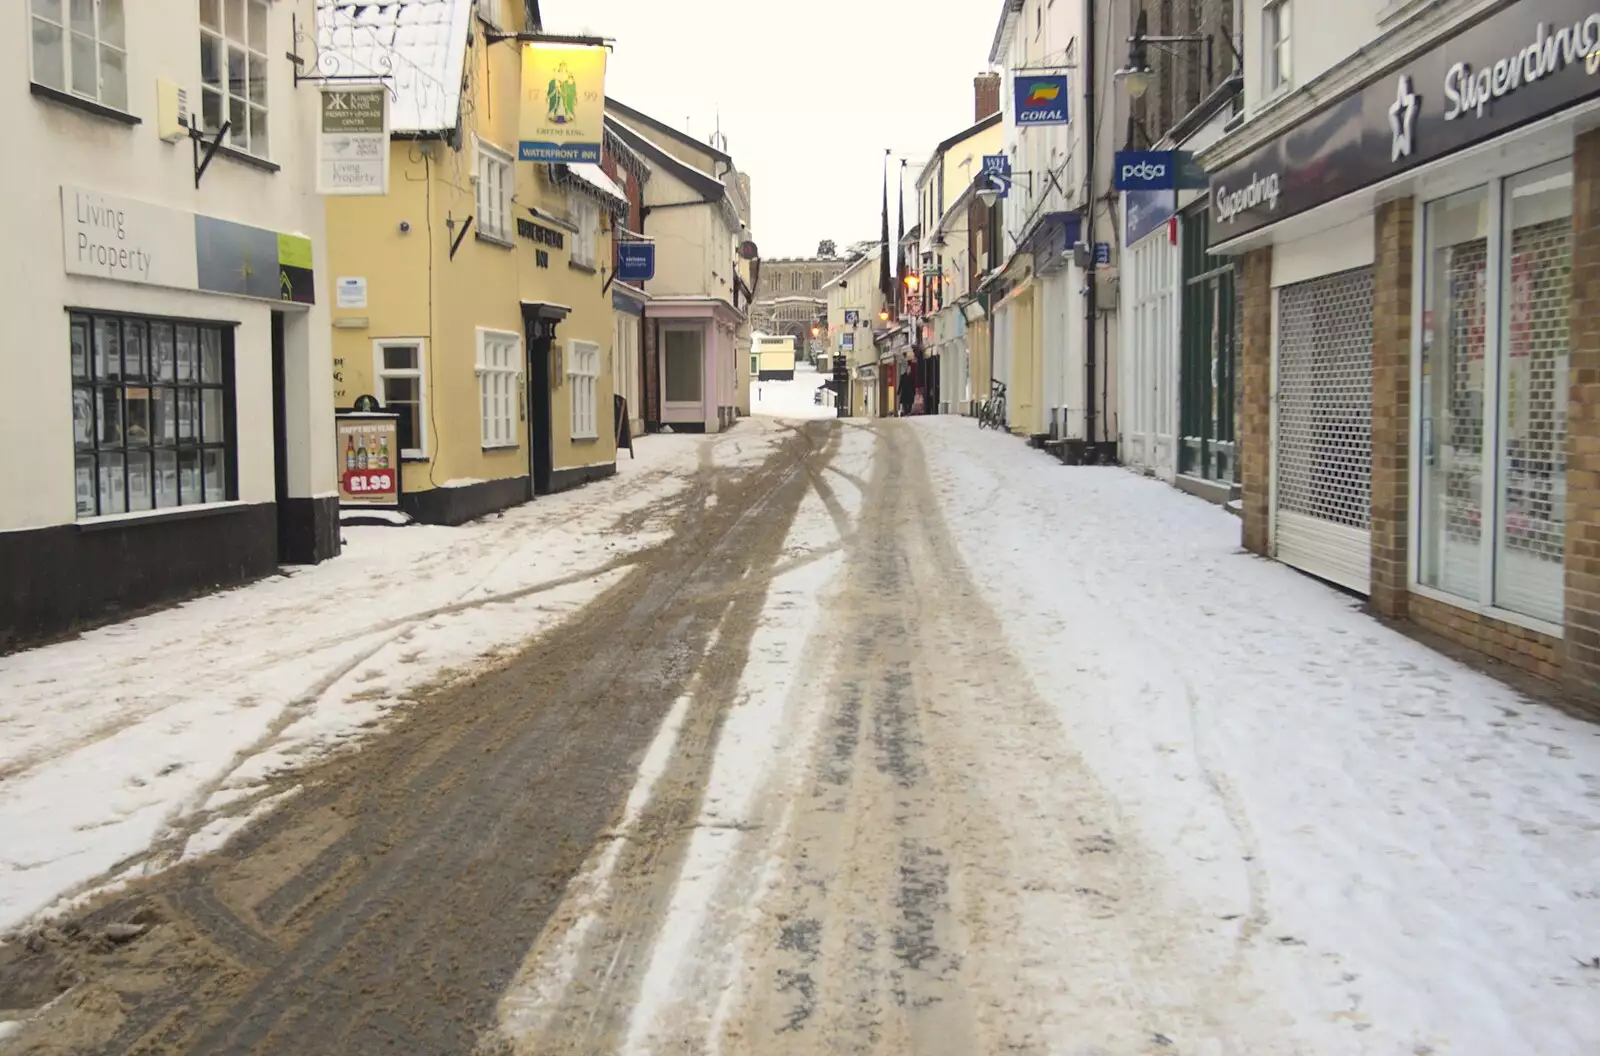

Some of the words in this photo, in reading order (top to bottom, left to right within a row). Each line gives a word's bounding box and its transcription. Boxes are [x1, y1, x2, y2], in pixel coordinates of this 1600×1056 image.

[1443, 12, 1600, 121] Superdrug
[1020, 110, 1062, 121] CORAL
[566, 128, 585, 136] KING
[522, 147, 578, 160] WATERFRONT
[581, 150, 597, 160] INN
[333, 161, 360, 174] Living
[1122, 160, 1165, 182] pdsa
[333, 172, 374, 184] Property
[1216, 172, 1280, 225] Superdrug
[75, 192, 126, 240] Living
[77, 231, 151, 280] Property
[350, 474, 391, 491] £1.99
